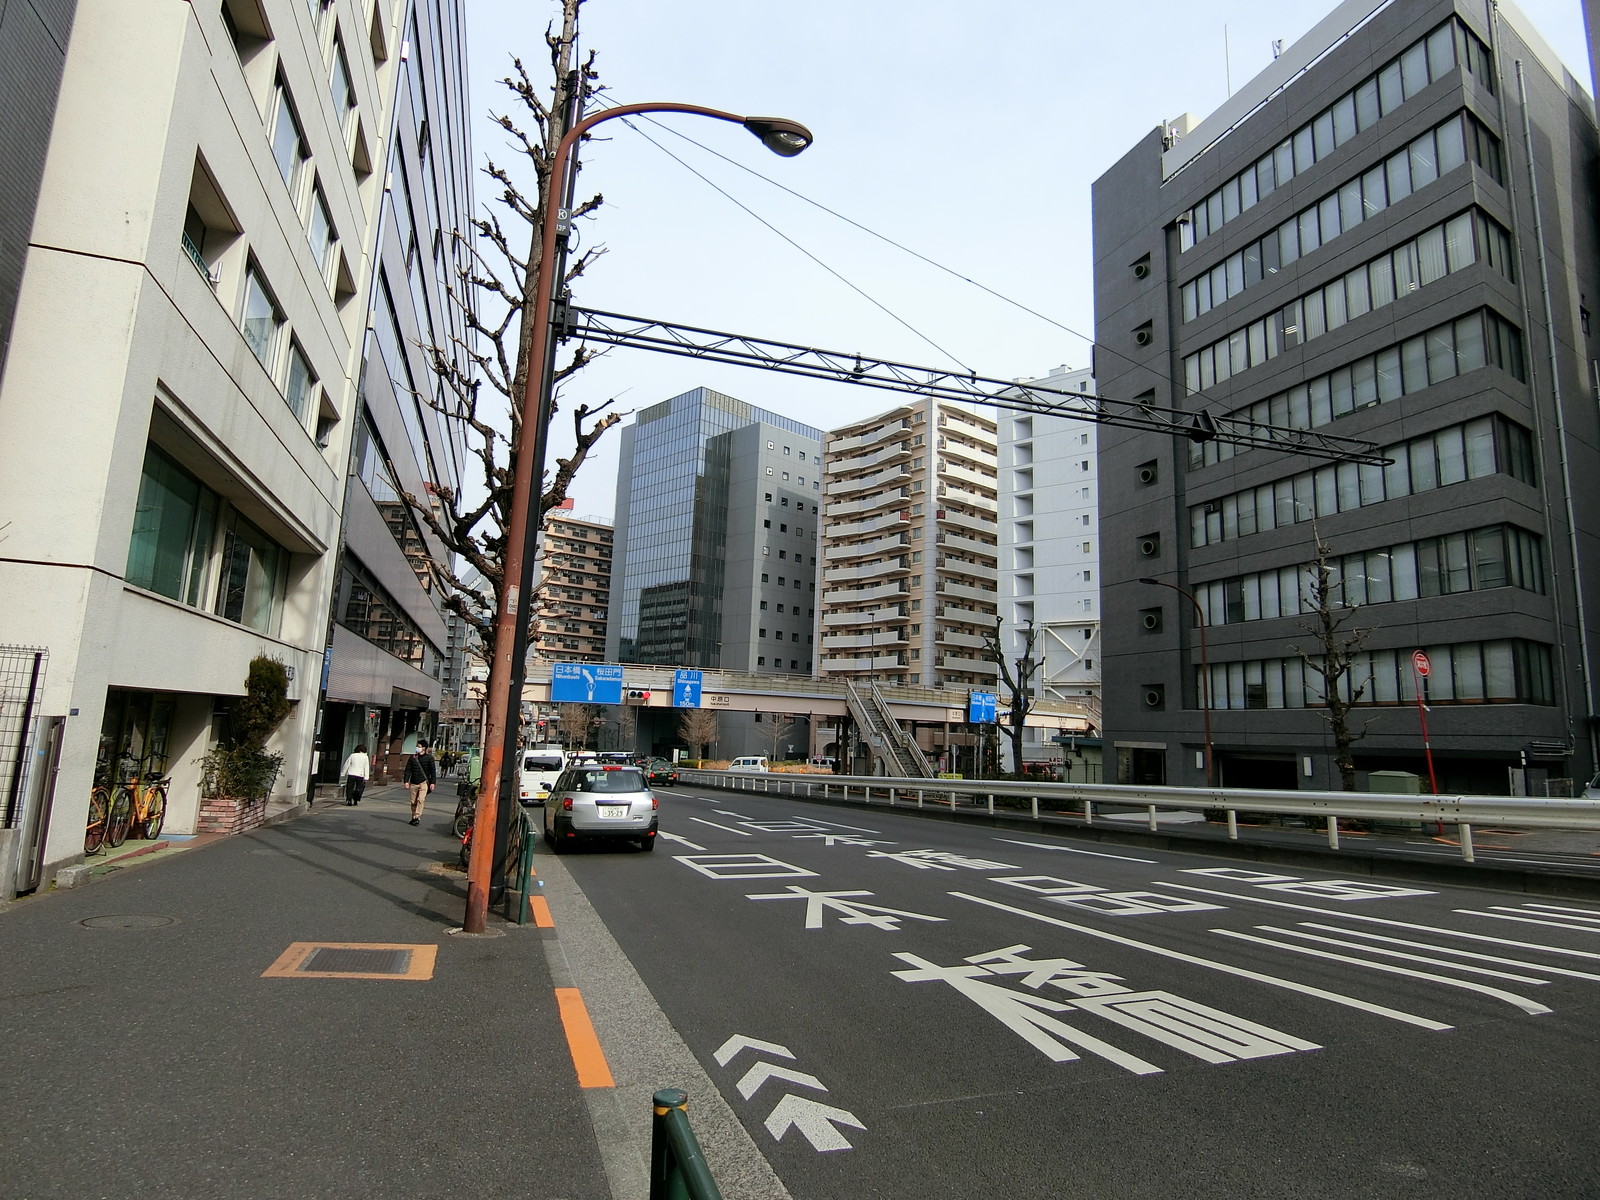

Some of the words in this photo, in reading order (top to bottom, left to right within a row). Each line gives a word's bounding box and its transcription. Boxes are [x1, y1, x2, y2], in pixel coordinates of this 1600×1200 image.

[555, 665, 581, 675] 日本橋
[596, 667, 622, 677] 桜田門
[680, 671, 698, 680] 品川
